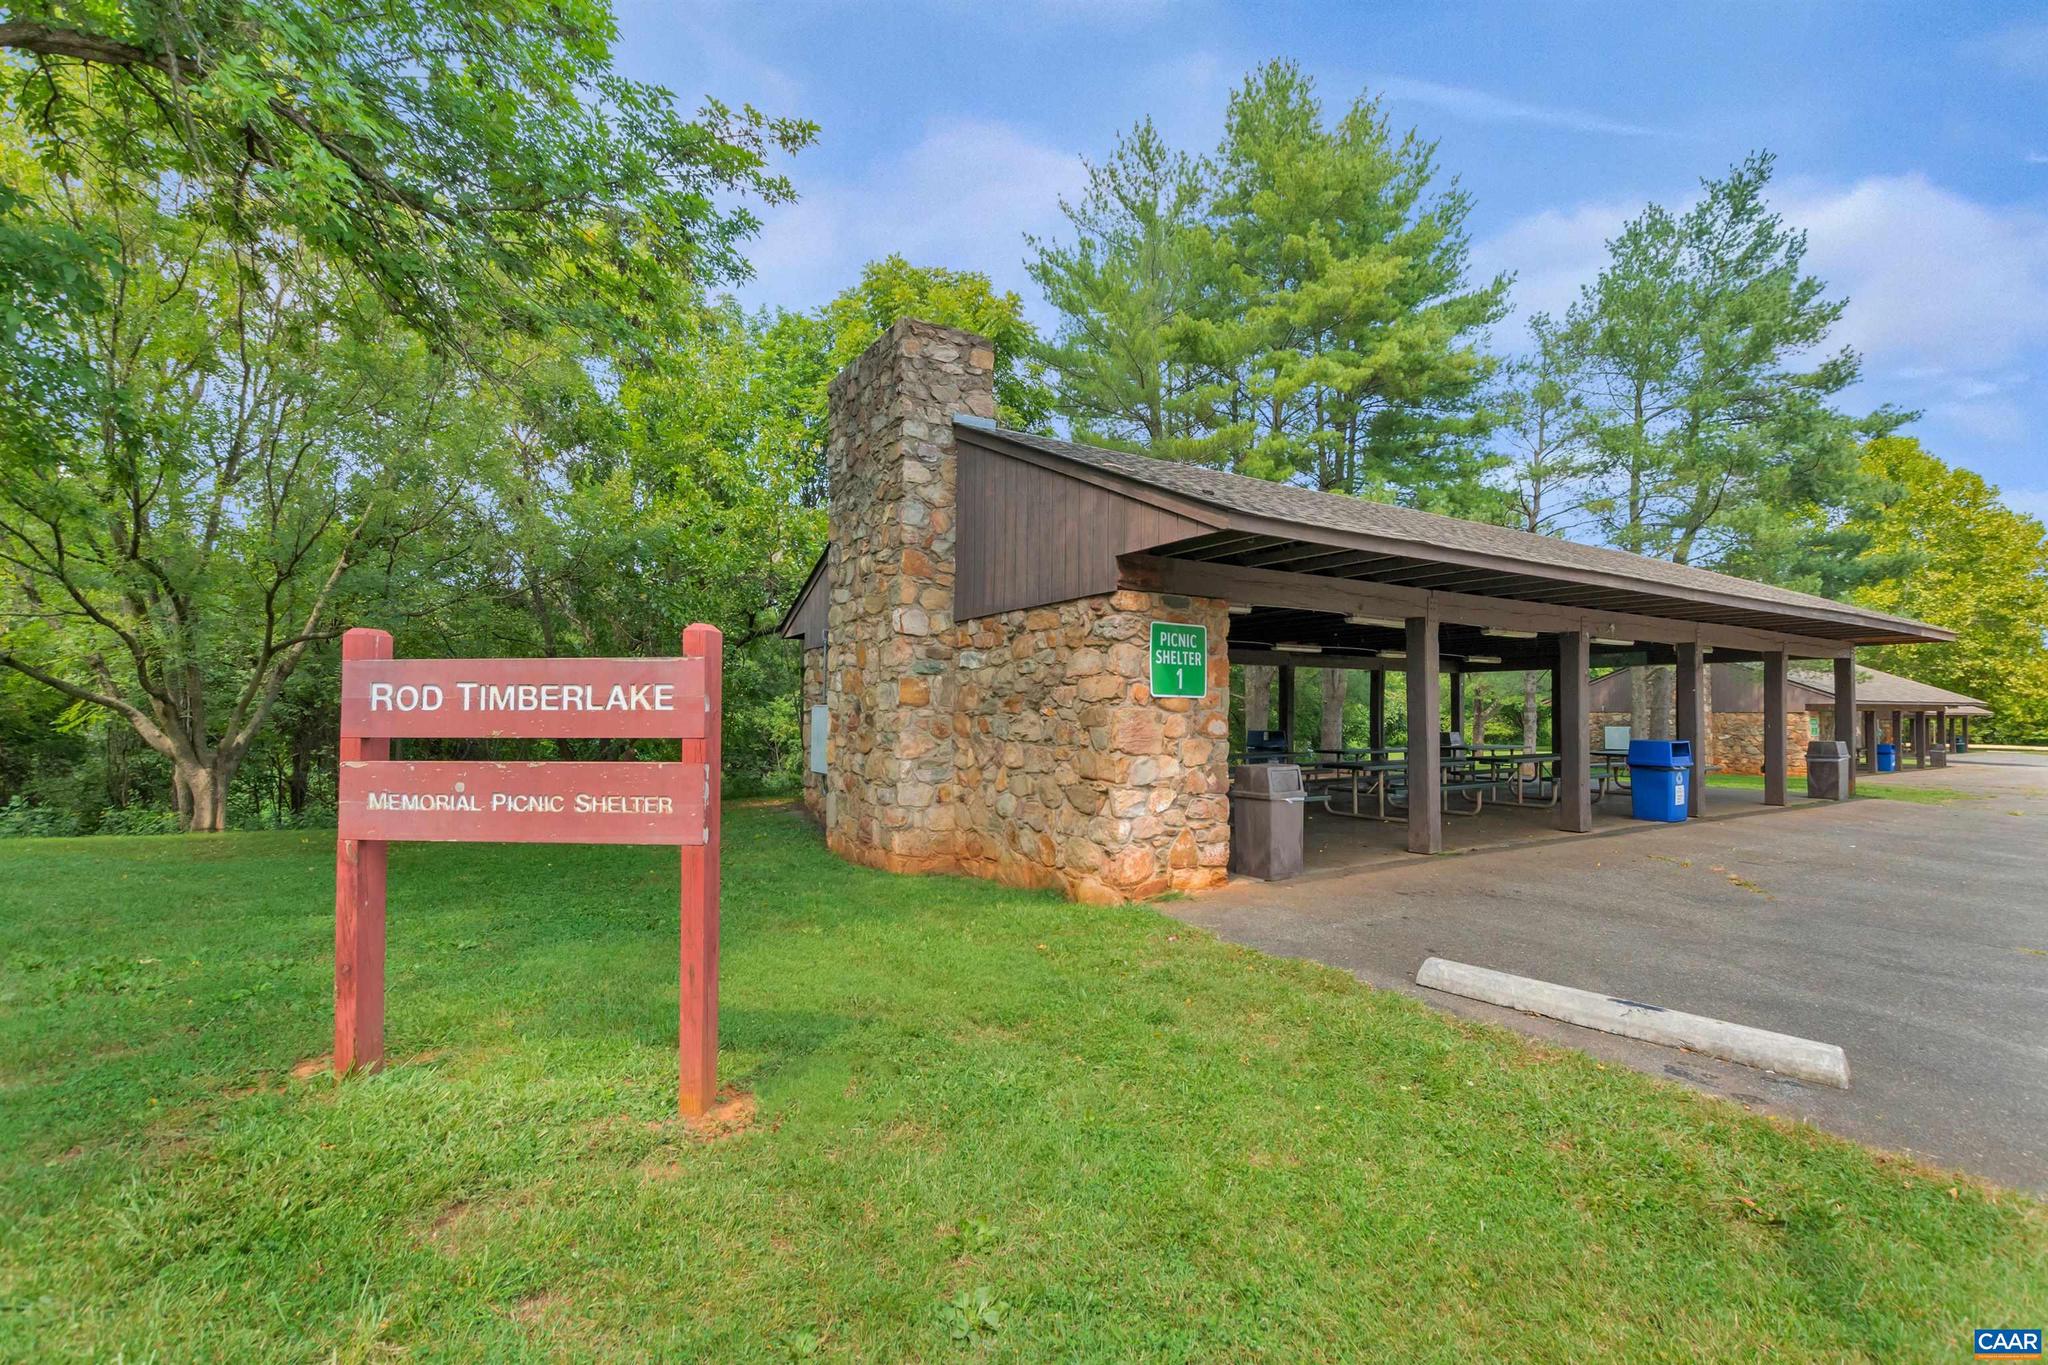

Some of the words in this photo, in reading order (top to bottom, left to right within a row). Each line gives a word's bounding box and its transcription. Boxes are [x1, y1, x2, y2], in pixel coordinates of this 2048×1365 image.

[1160, 631, 1198, 648] PICNIC
[1155, 649, 1202, 666] SHELTER
[1176, 668, 1183, 690] 1
